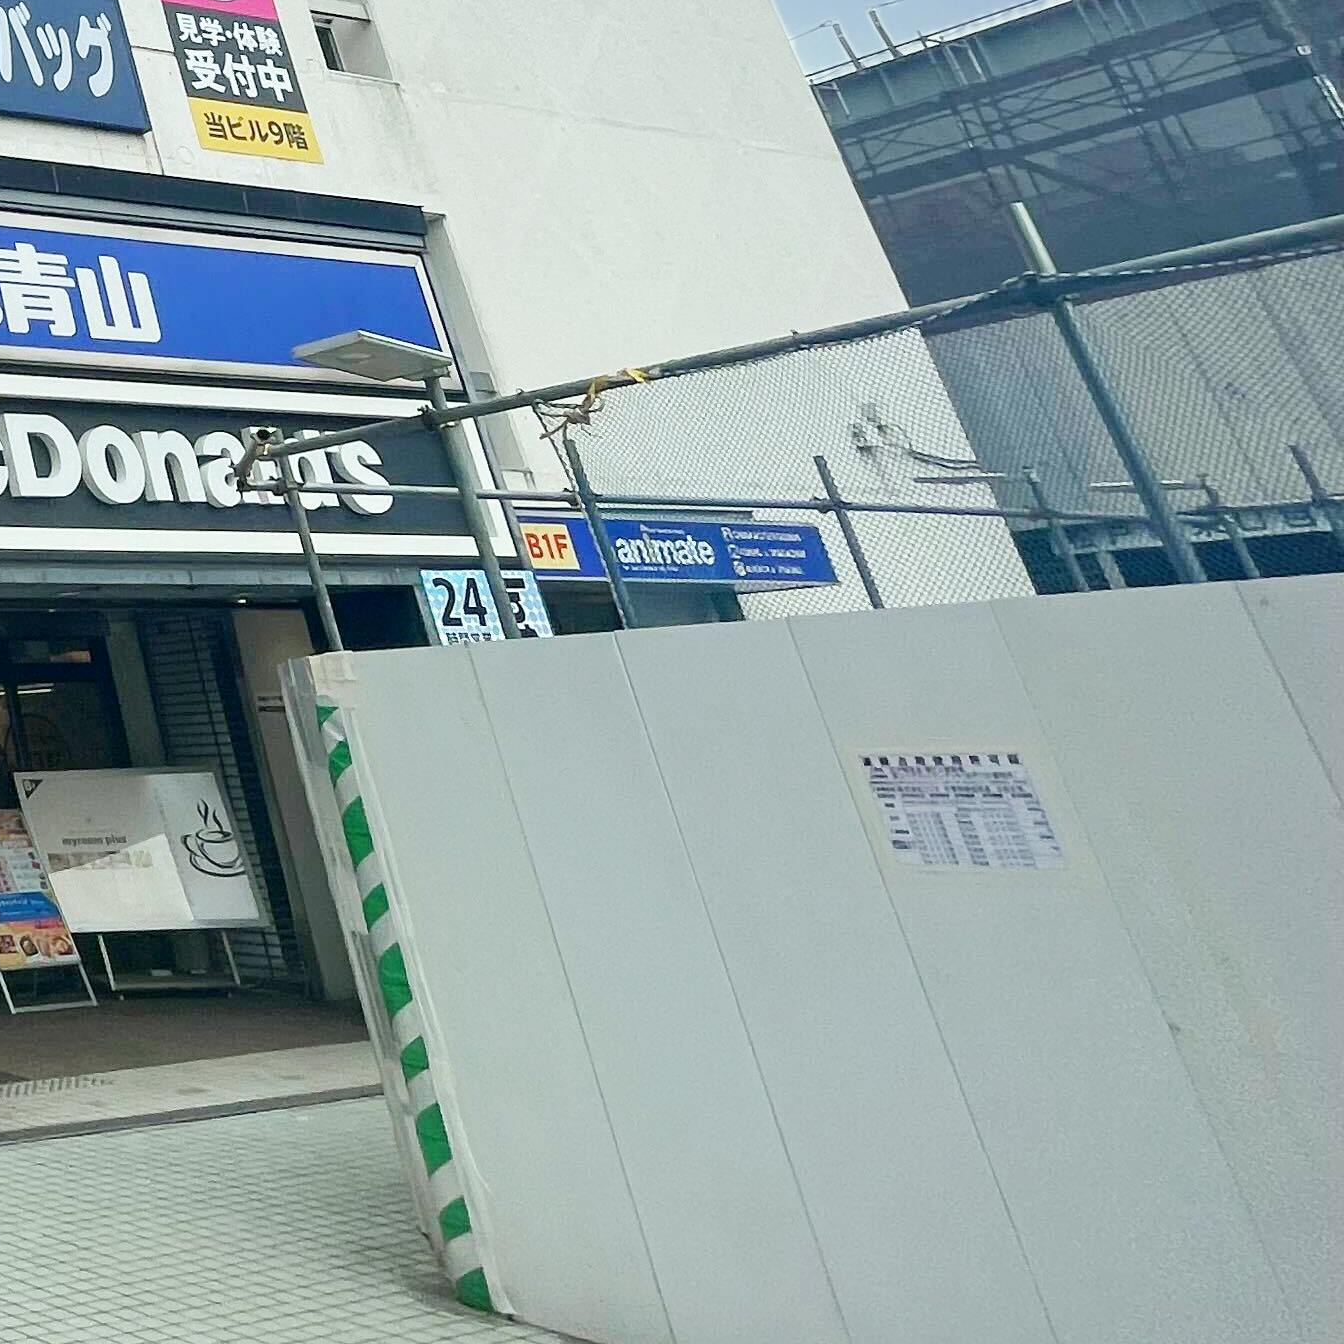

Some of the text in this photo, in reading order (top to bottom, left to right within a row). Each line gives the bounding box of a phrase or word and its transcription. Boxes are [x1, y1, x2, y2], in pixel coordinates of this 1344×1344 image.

[185, 47, 294, 103] 受付中
[203, 111, 310, 151] 当ビル9階
[523, 531, 572, 560] B1F
[615, 532, 715, 566] animate
[432, 577, 488, 627] 24
